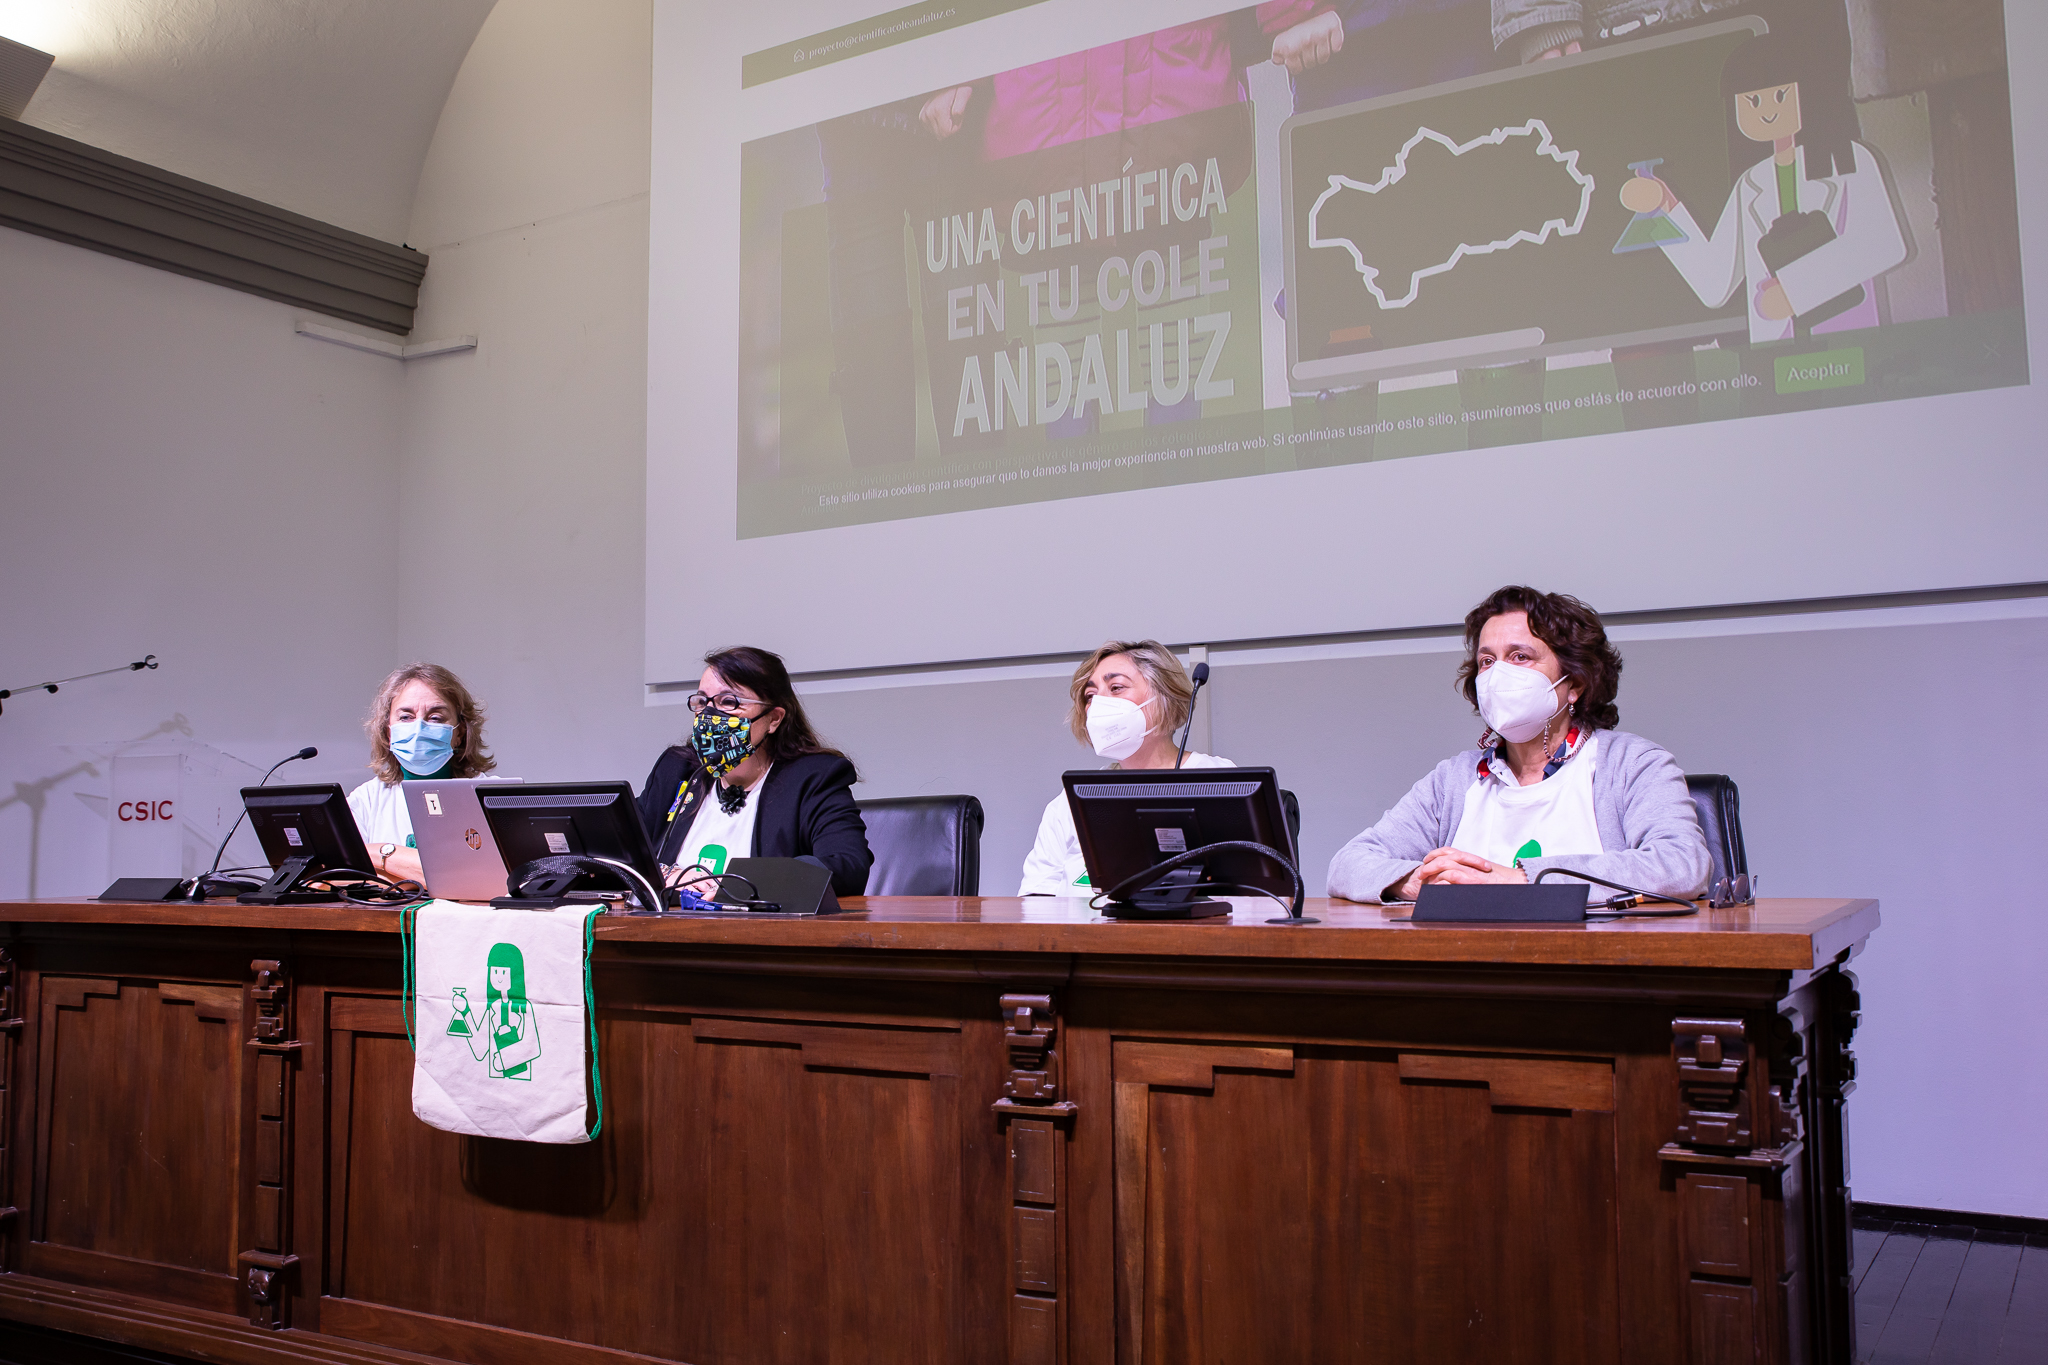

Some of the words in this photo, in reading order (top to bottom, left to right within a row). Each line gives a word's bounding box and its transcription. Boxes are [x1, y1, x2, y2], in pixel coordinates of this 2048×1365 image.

[927, 207, 1000, 273] UNA
[1010, 156, 1228, 255] CIENTÍFICA
[947, 279, 1005, 341] EN
[1019, 265, 1079, 327] TU
[1096, 234, 1230, 312] COLE
[953, 311, 1235, 437] ANDALUZ
[1786, 361, 1852, 382] Aceptar
[841, 491, 860, 504] sitio
[862, 488, 888, 501] utiliza
[890, 483, 926, 497] cookies
[928, 480, 950, 494] para
[953, 473, 996, 490] asegurar
[999, 470, 1017, 484] que
[1032, 464, 1067, 477] damos
[1069, 460, 1080, 473] la
[1082, 456, 1112, 472] mejor
[1115, 447, 1176, 467] experiencia
[1180, 447, 1194, 459] en
[1196, 439, 1239, 456] nuestra
[1241, 435, 1269, 450] web.
[1273, 433, 1285, 446] Si
[1288, 425, 1345, 443] continúas
[1348, 419, 1394, 436] usando
[1397, 415, 1424, 430] este
[1428, 411, 1457, 427] sitio,
[1461, 401, 1541, 423] asumiremos
[1545, 398, 1570, 414] que
[1574, 388, 1612, 408] estás
[1615, 386, 1633, 402] de
[1637, 381, 1696, 400] acuerdo
[1700, 378, 1727, 393] con
[1731, 372, 1762, 389] ello.
[118, 800, 173, 821] CSIC
[466, 828, 481, 850] hp
